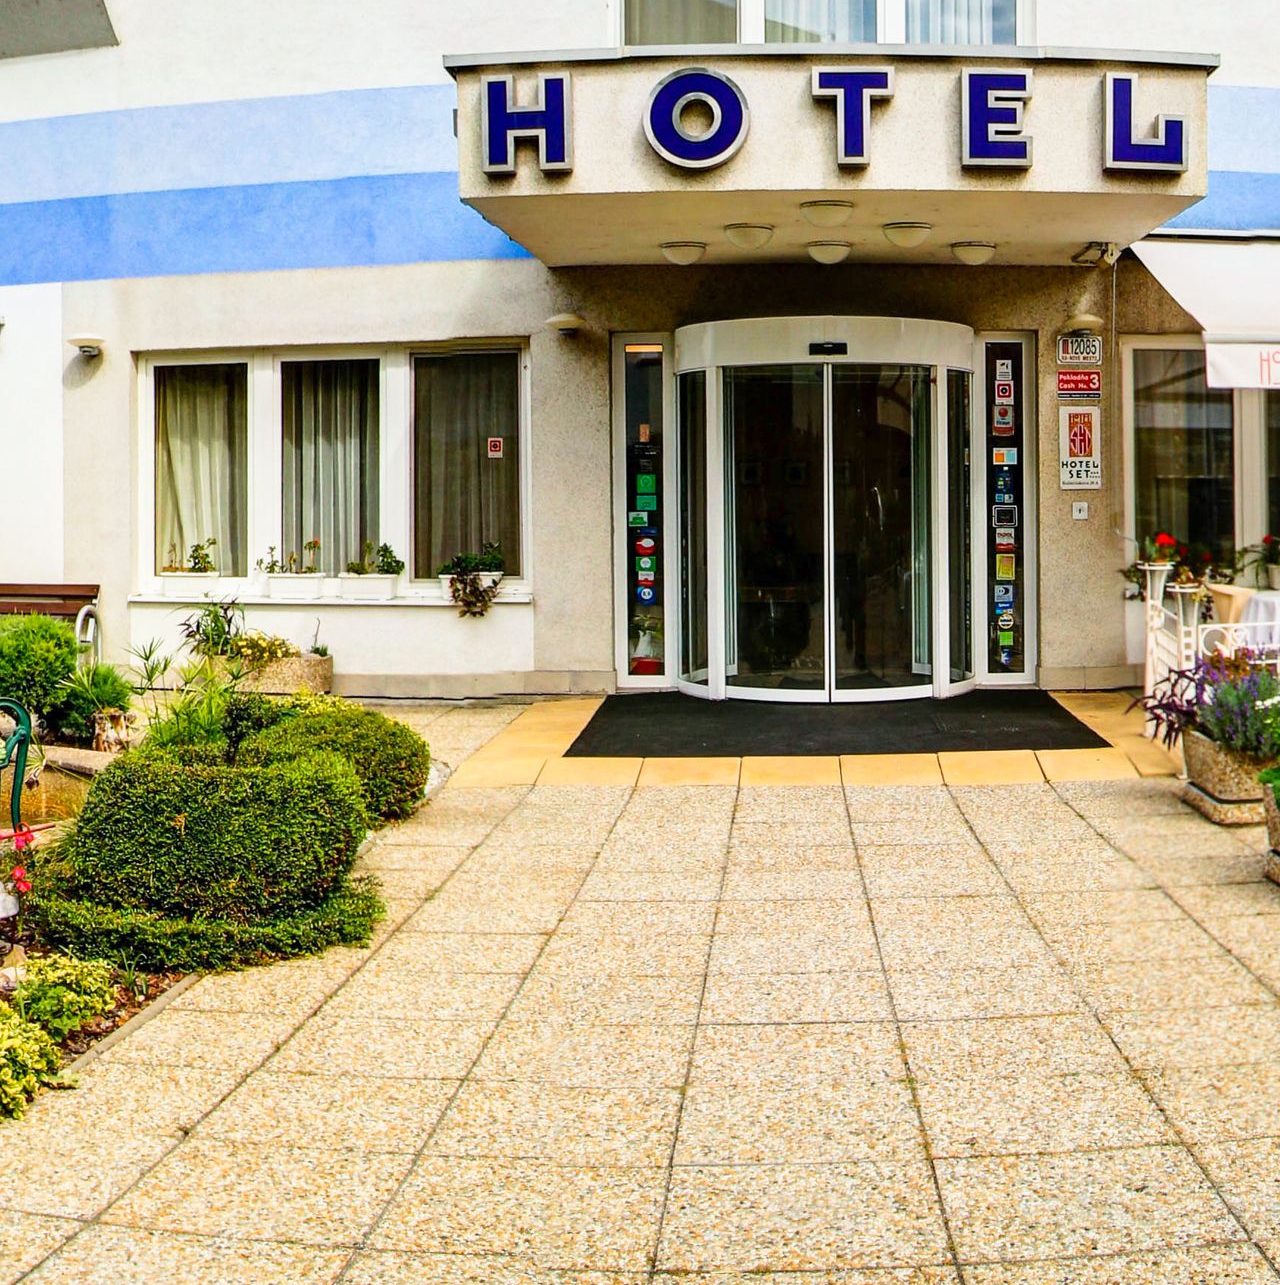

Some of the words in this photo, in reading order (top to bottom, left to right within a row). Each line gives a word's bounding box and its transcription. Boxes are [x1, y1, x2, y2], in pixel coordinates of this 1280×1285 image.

[481, 66, 1188, 173] HOTEL
[1070, 338, 1097, 355] 12085
[1089, 374, 1099, 389] 3
[1061, 460, 1099, 469] HOTEL
[1069, 470, 1090, 479] SET
